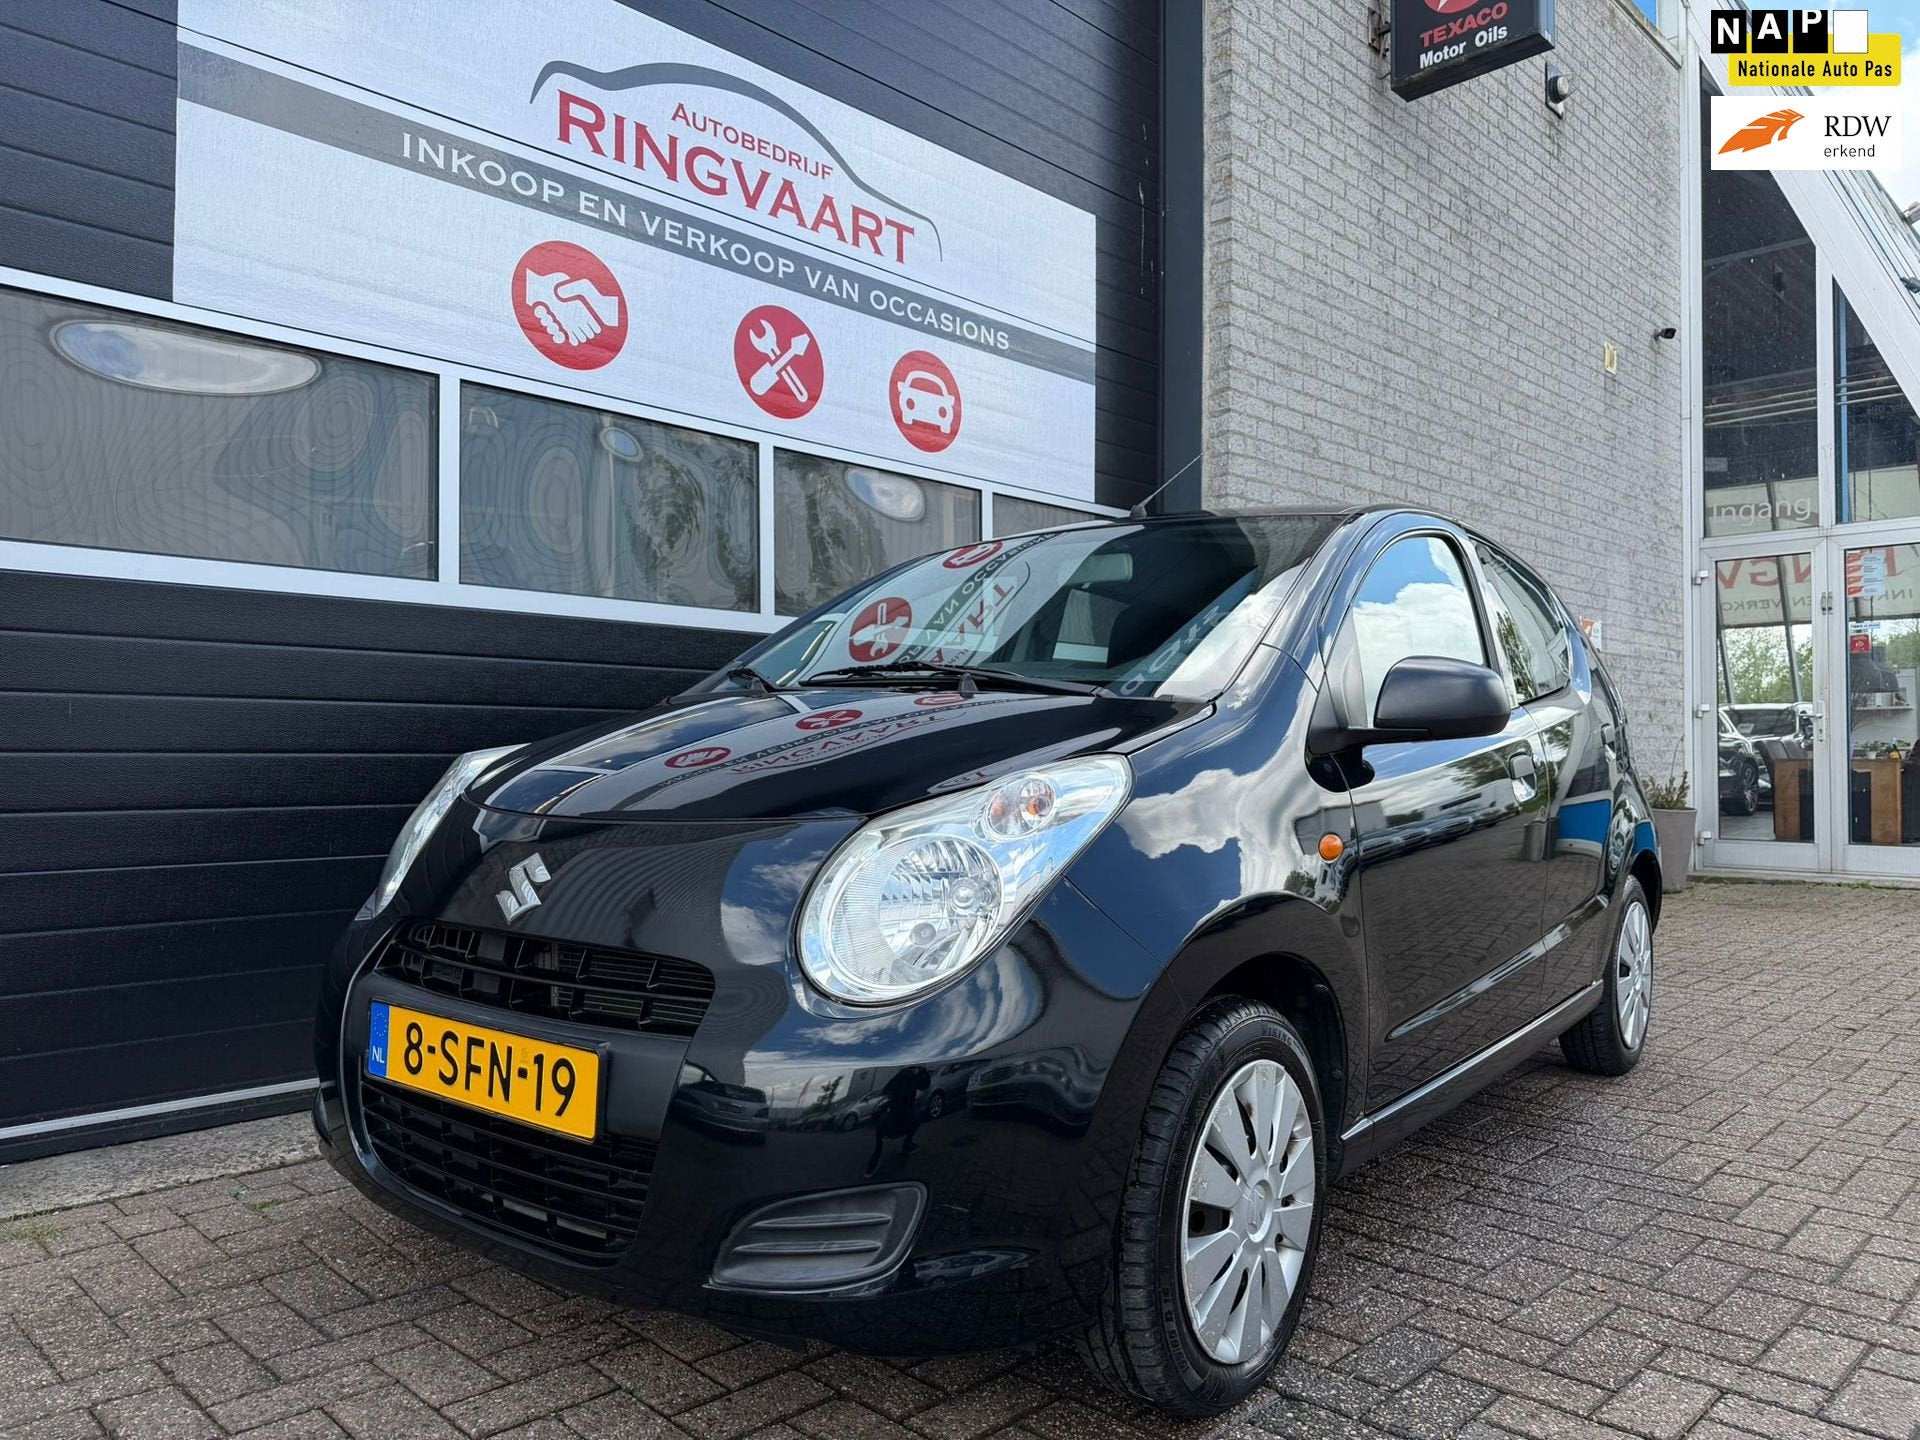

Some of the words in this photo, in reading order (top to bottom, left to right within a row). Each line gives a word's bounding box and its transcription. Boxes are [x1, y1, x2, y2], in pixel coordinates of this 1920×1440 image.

[1420, 2, 1508, 47] TEXACO
[1420, 40, 1467, 69] Motor
[1474, 25, 1508, 47] Oils
[671, 102, 834, 180] AUTOBEDRIJF
[556, 89, 915, 264] RINGVAART
[401, 132, 565, 204] INKOOP
[579, 193, 628, 227] EN
[640, 211, 796, 279] VERKOOP
[804, 265, 860, 302] VAN
[868, 288, 1010, 351] OCCASIONS
[1712, 497, 1811, 527] Ingang
[372, 1046, 385, 1064] NL
[403, 1021, 576, 1117] 8-SFN-19
